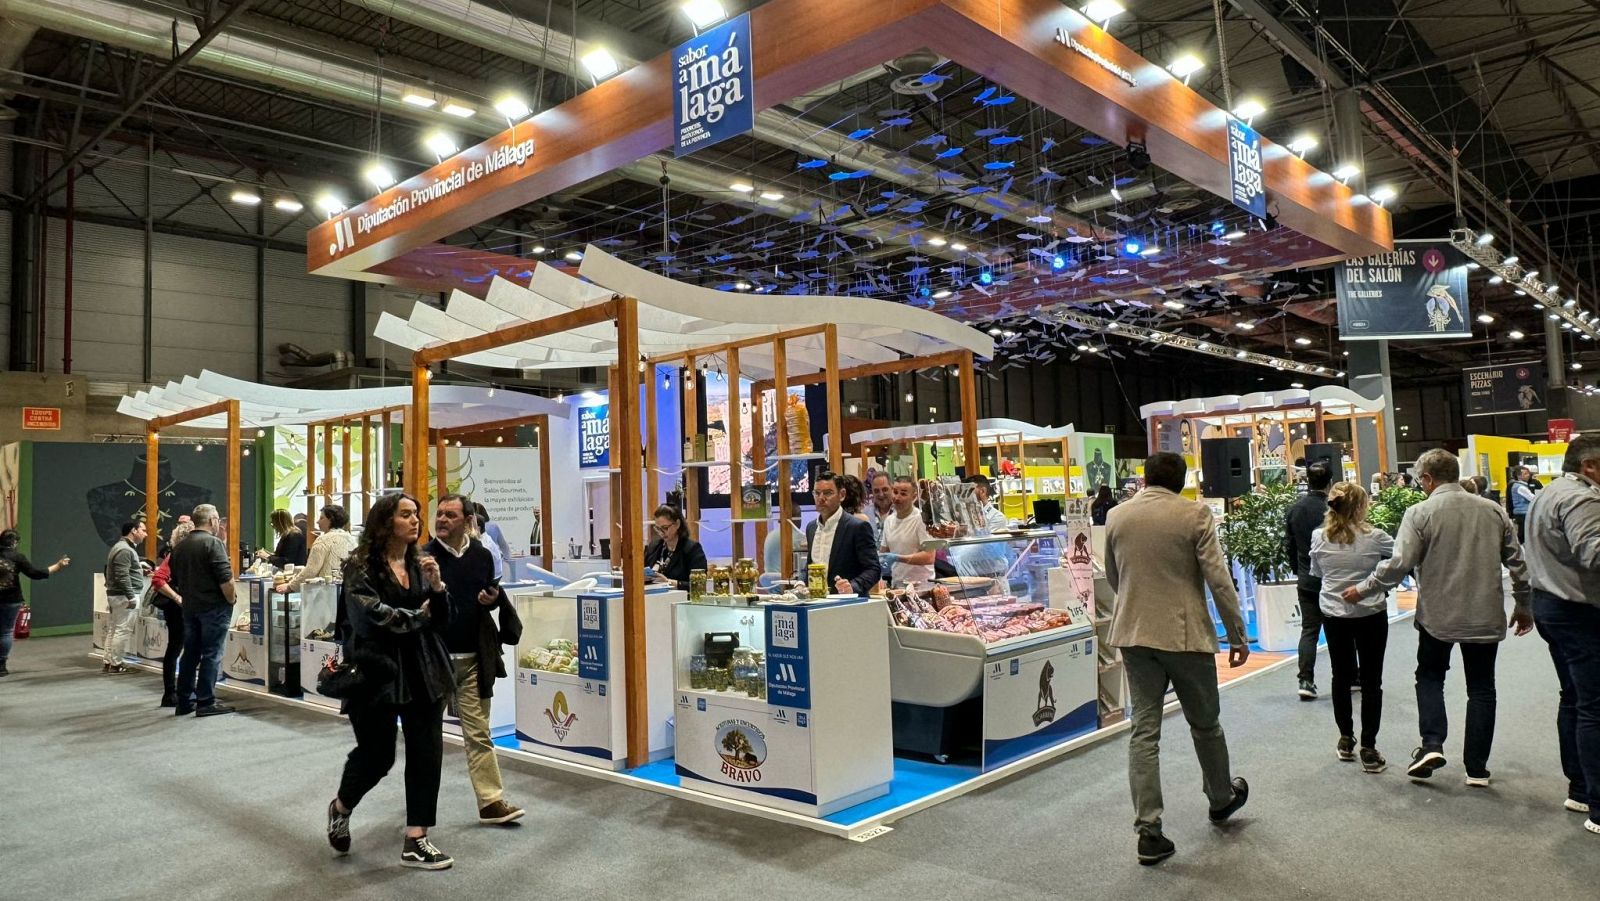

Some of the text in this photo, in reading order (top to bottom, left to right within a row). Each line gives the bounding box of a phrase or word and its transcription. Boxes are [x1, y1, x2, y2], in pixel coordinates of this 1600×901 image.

[678, 44, 709, 67] sabor
[679, 31, 744, 93] a má
[680, 77, 744, 125] laga
[1231, 137, 1262, 172] a má
[1232, 152, 1264, 197] laga
[357, 139, 534, 235] Diputación Provincial de Málaga
[1368, 247, 1416, 266] GALERÍAS
[1346, 264, 1402, 283] DEL SALÓN
[1347, 290, 1357, 298] THE
[1470, 370, 1504, 381] ESCENARIO
[1470, 379, 1492, 389] PIZZAS
[581, 410, 596, 420] sabor
[581, 420, 586, 428] a
[582, 430, 609, 455] laga
[583, 613, 598, 624] laga
[778, 616, 795, 629] má
[775, 625, 795, 640] laga
[720, 761, 762, 783] BRAVO
